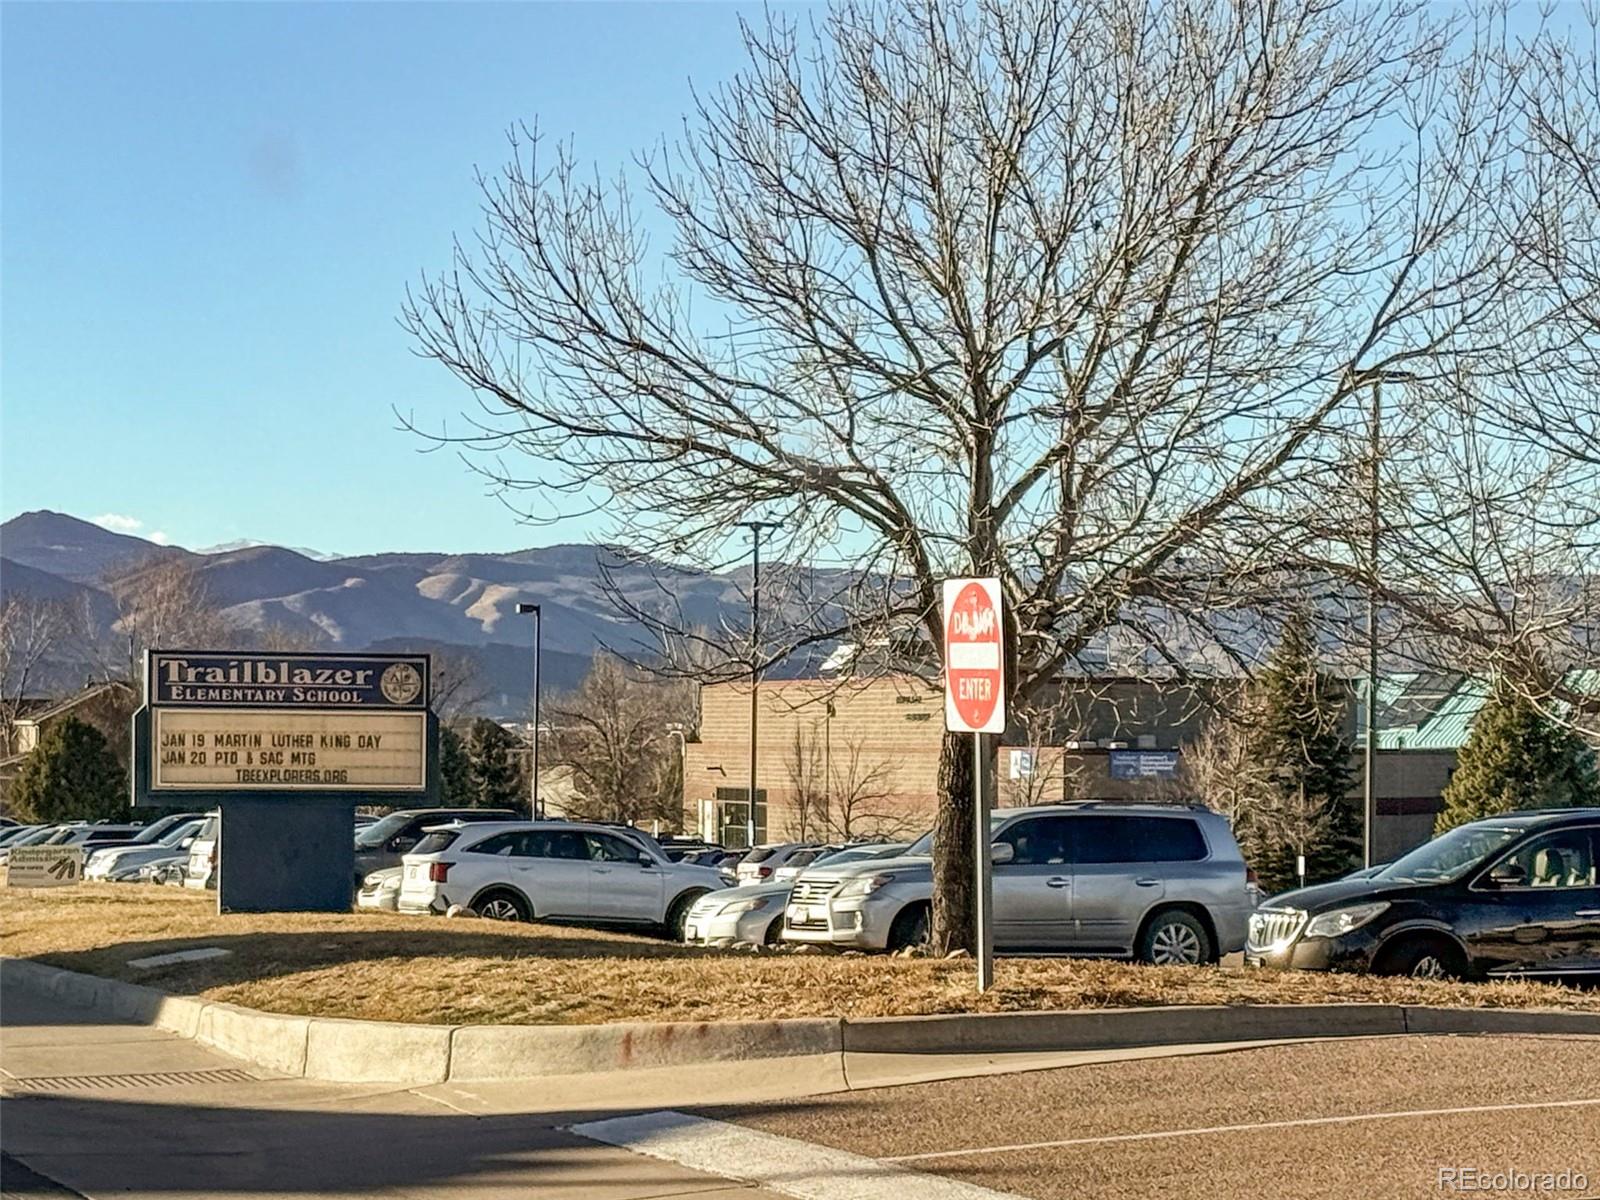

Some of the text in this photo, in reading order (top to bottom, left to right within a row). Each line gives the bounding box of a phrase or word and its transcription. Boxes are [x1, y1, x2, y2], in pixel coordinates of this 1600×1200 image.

[160, 660, 373, 685] Trailblazer
[959, 678, 992, 700] ENTER
[161, 734, 381, 748] JAN 19 MARTIN LUTHER KING DAY
[161, 752, 185, 764] JAN
[190, 751, 206, 764] 20
[214, 752, 238, 764] PTO
[260, 752, 284, 765] SAC
[290, 752, 316, 765] MTG
[236, 769, 348, 782] TBEEXPLORERS.ORG
